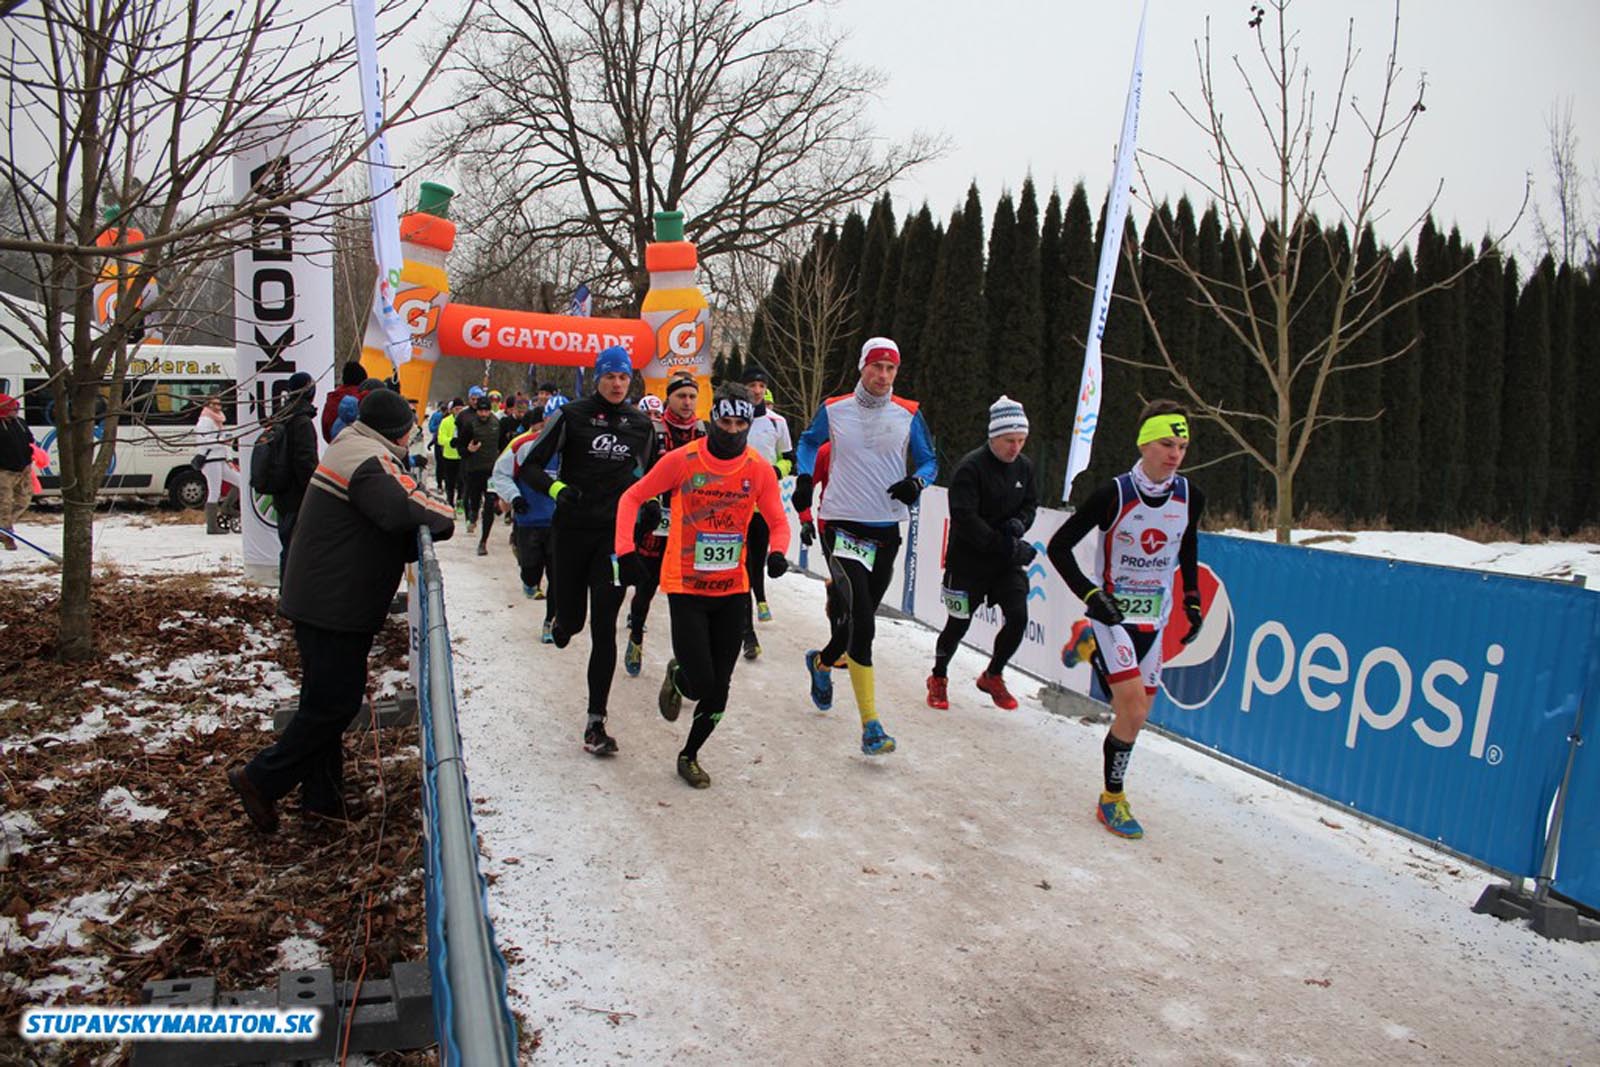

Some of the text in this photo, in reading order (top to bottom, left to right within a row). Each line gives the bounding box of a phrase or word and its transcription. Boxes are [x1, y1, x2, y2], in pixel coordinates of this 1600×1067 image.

[497, 326, 635, 353] GATORADE
[703, 546, 734, 562] 931
[1118, 598, 1153, 614] 923
[1240, 620, 1505, 760] pepsi
